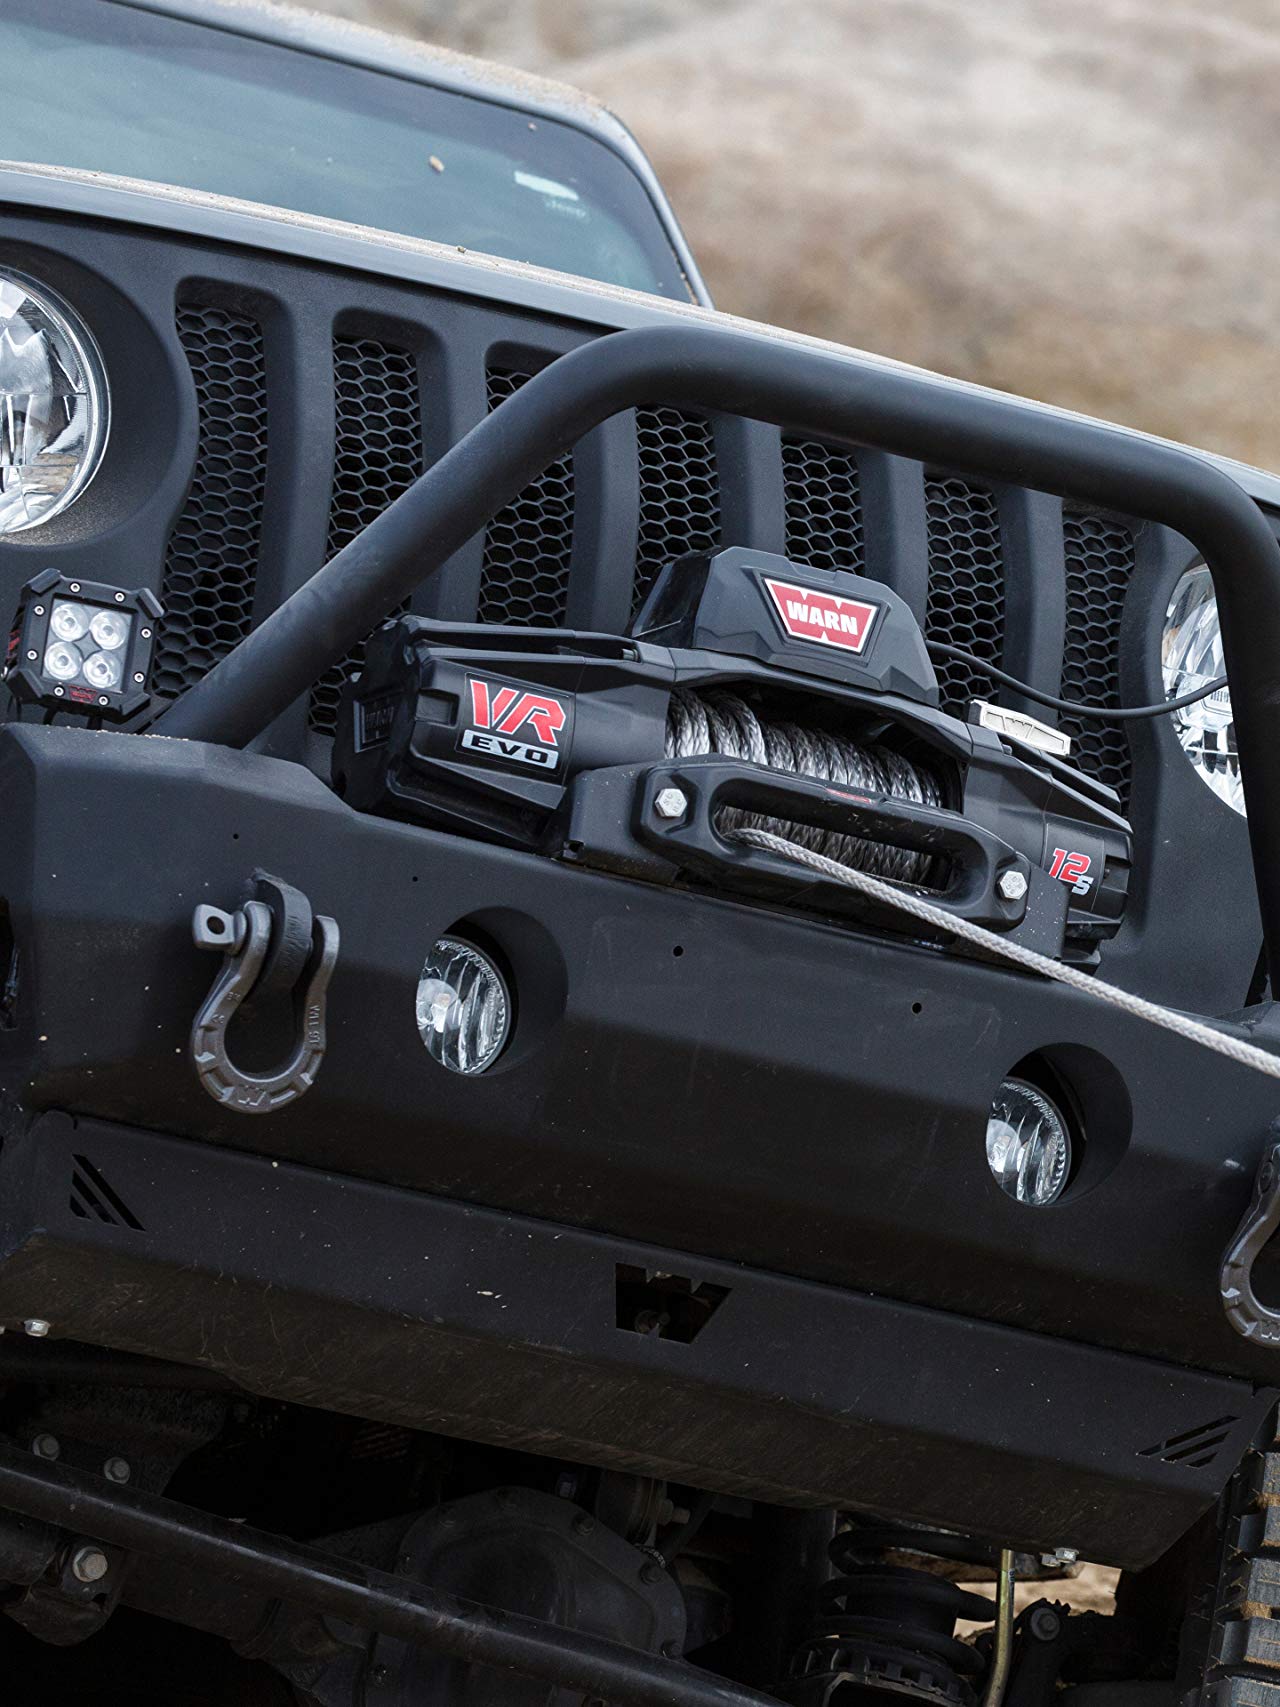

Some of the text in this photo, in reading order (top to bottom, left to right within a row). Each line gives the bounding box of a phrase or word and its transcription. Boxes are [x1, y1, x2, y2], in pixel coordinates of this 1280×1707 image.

[786, 600, 858, 635] WARN
[470, 679, 566, 746] VR
[471, 734, 549, 764] EVO
